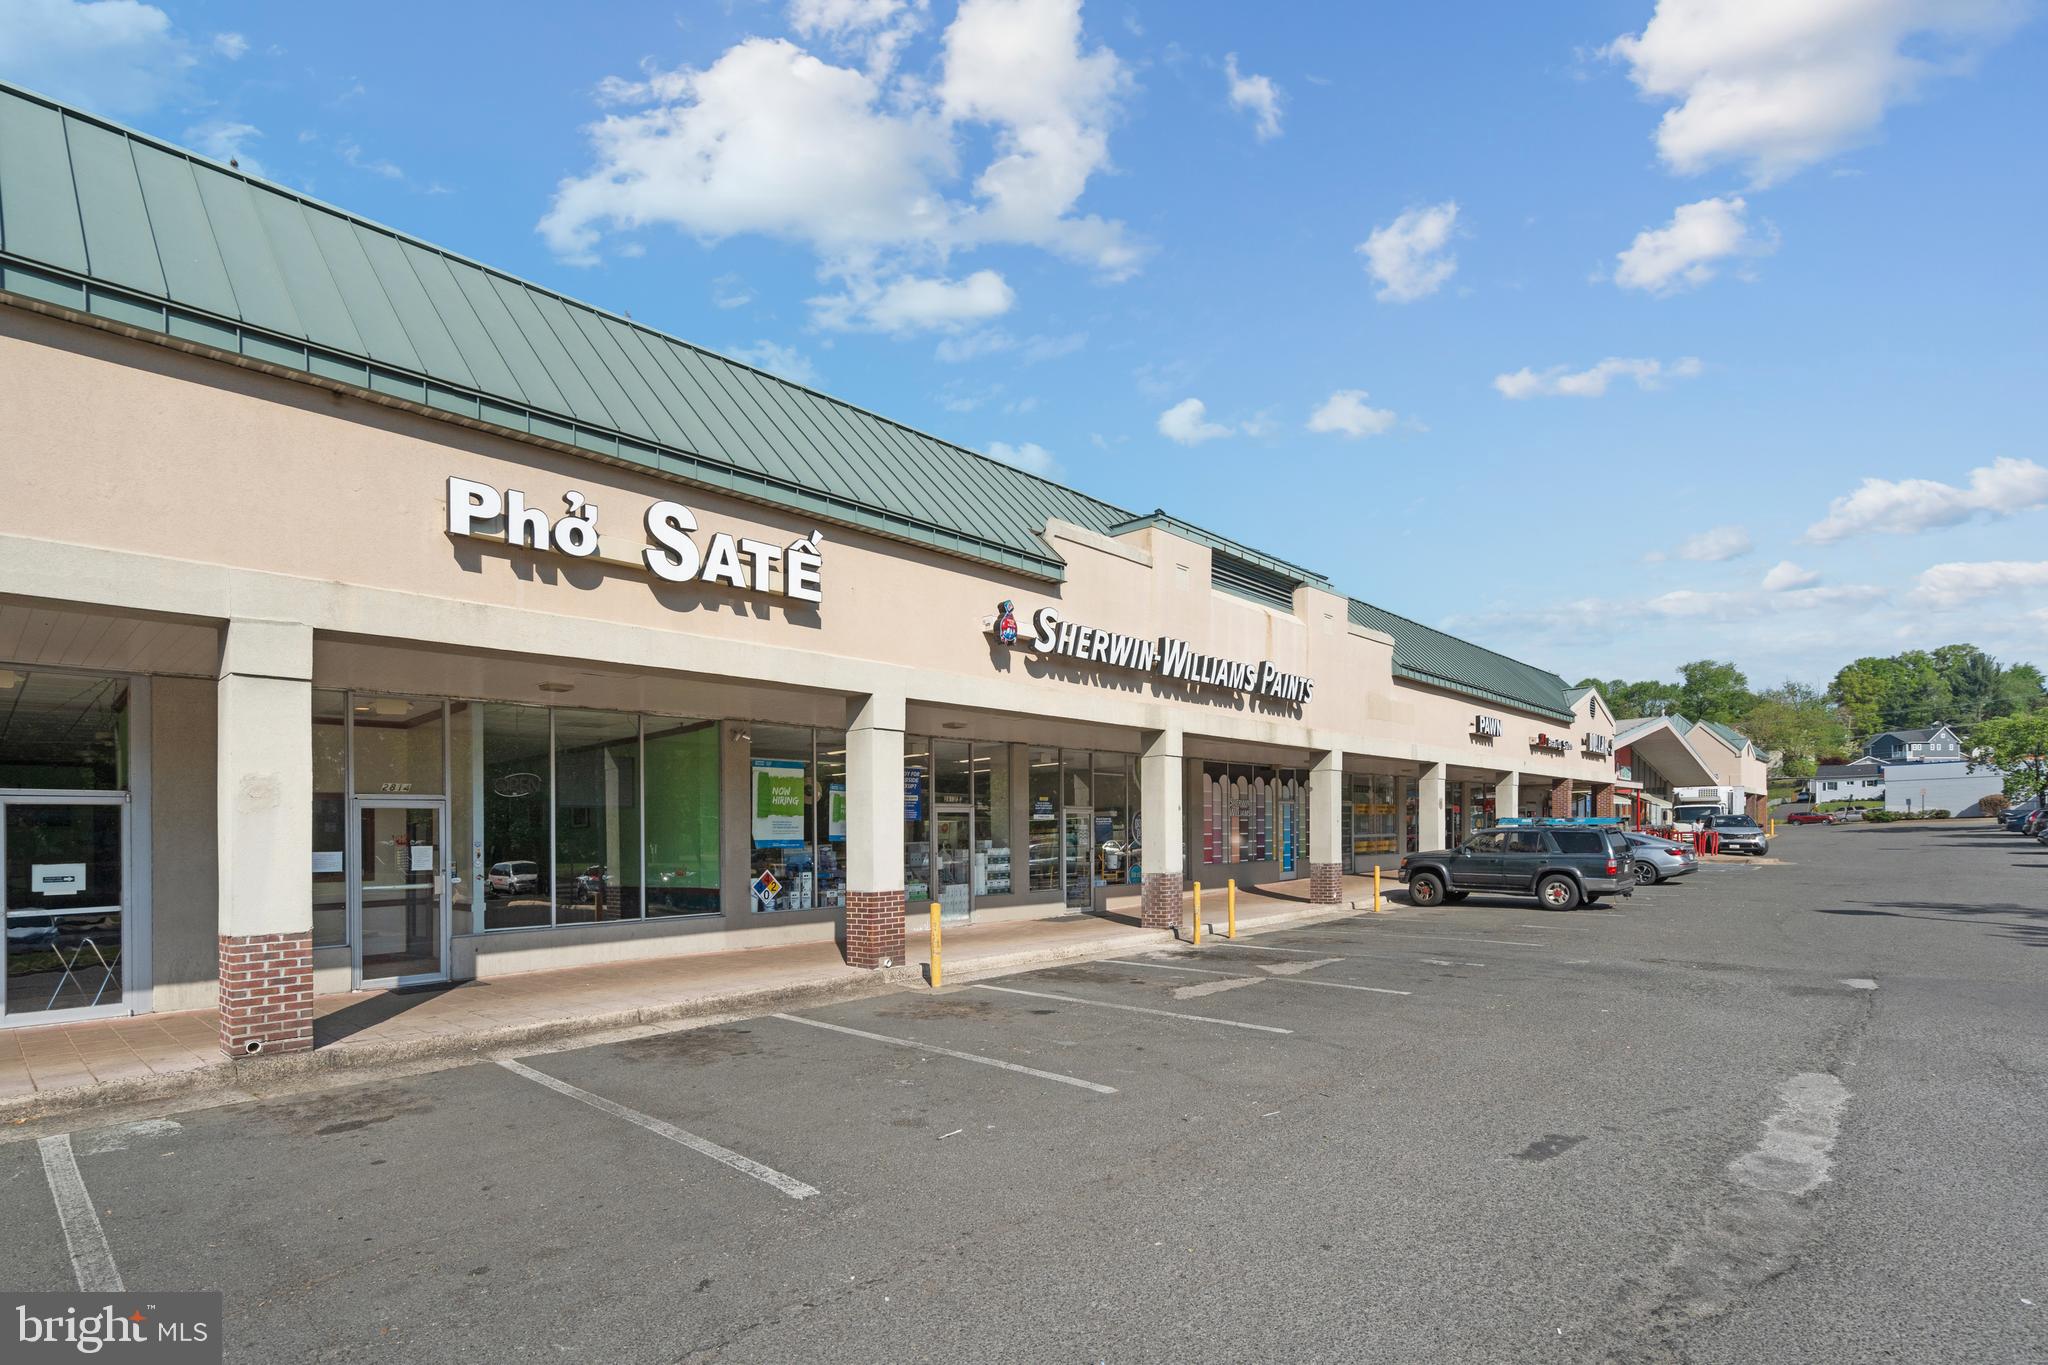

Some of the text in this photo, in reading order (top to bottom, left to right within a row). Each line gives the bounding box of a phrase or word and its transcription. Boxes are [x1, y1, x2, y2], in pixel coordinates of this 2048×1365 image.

[1259, 660, 1314, 704] PAINTS
[1477, 715, 1502, 737] PAWN
[772, 787, 791, 796] NOW
[771, 882, 777, 891] 2
[763, 890, 770, 900] 0
